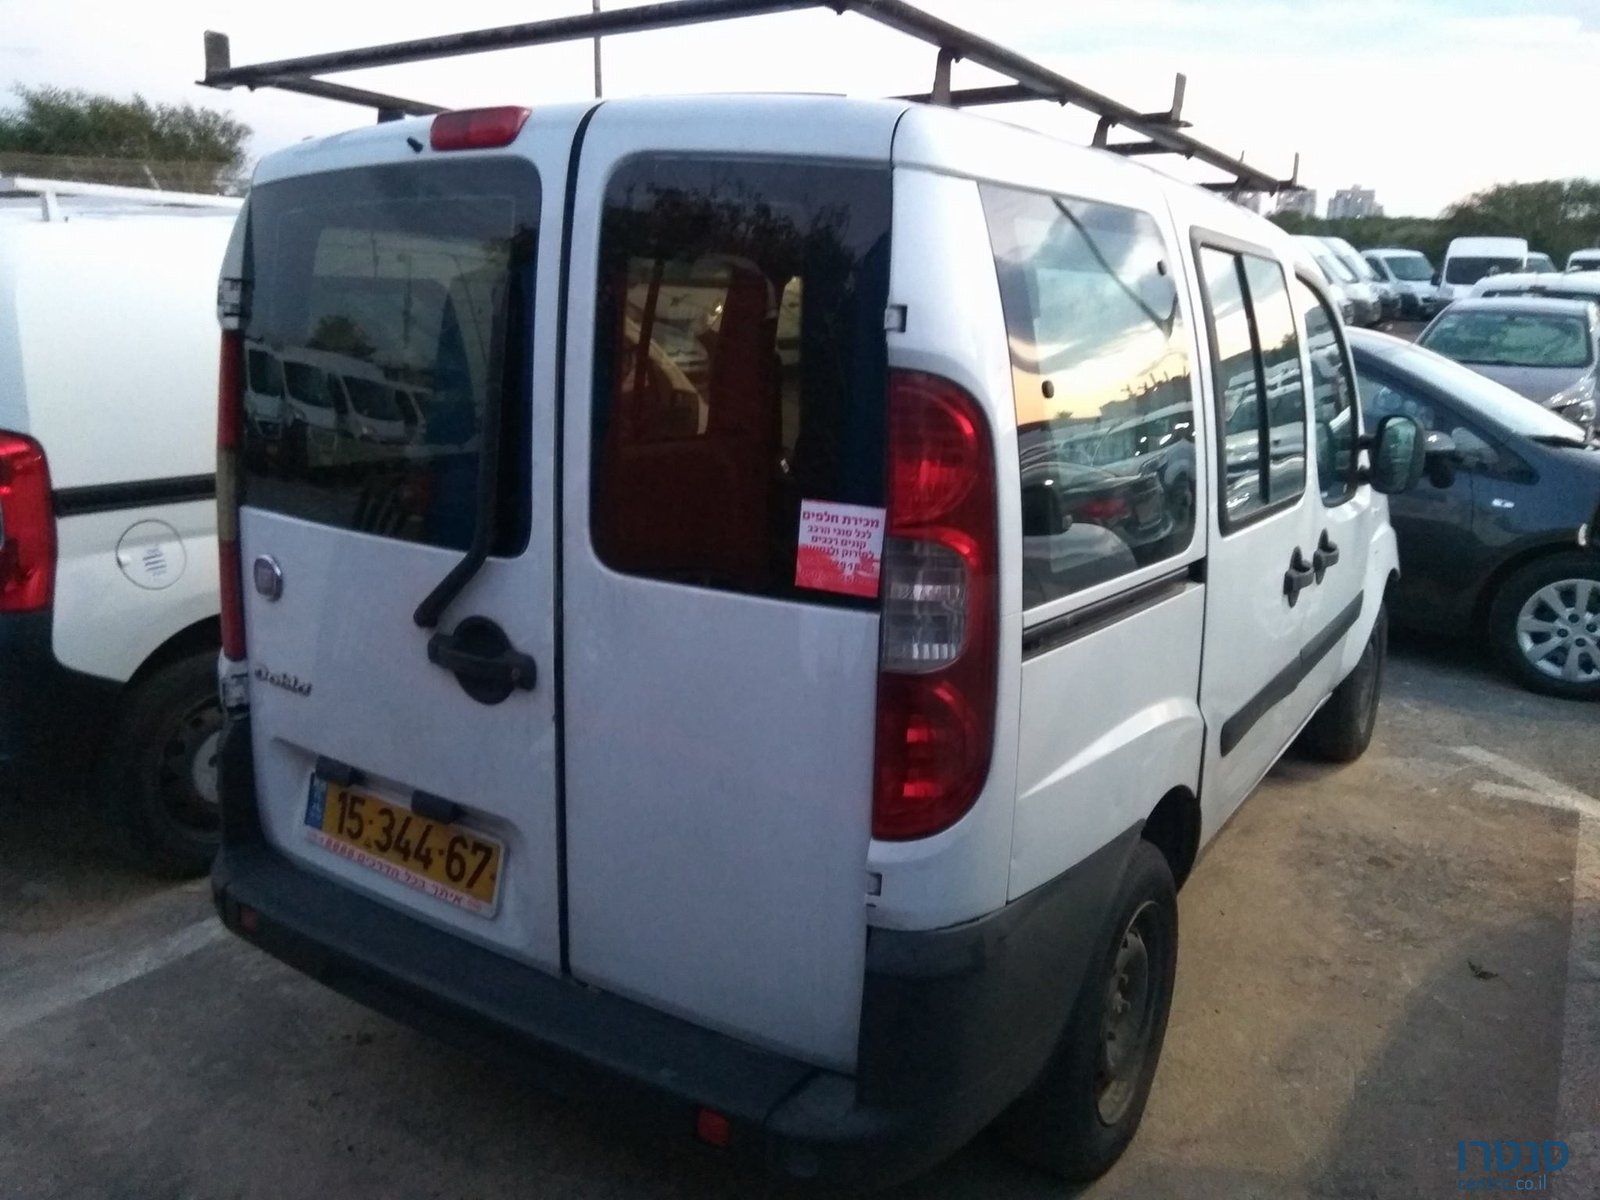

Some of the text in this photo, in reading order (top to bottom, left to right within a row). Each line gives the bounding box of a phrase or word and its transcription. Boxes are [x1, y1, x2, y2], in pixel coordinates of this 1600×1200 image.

[802, 511, 880, 528] מכירת חלפים
[807, 525, 872, 539] לכל סוגי הרכב
[811, 535, 867, 550] קונים רכבים
